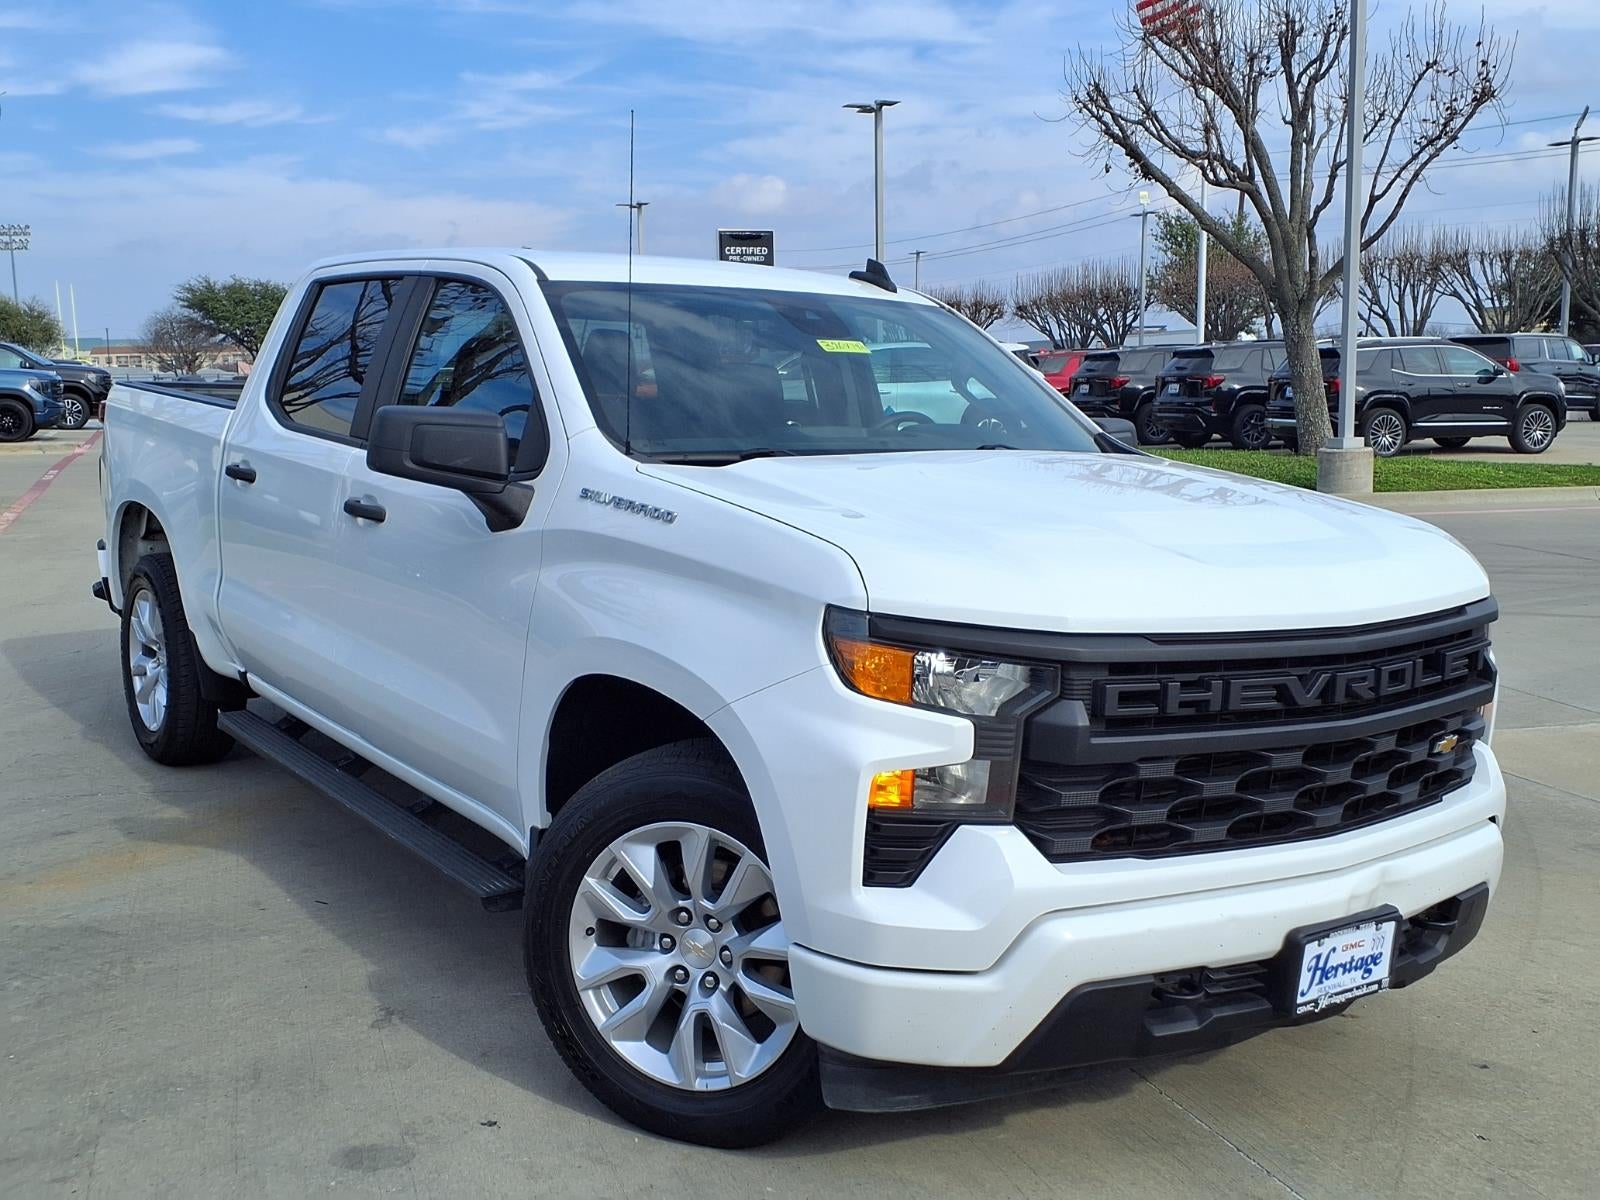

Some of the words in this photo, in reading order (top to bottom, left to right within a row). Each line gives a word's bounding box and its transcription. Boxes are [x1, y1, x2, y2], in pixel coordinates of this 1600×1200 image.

[725, 246, 768, 255] CERTIFIED
[579, 487, 678, 525] SILVERADO
[1103, 639, 1491, 717] CHEVROLET
[1342, 939, 1366, 952] GMC
[1299, 946, 1383, 998] Heritage
[1296, 1003, 1315, 1014] GMC
